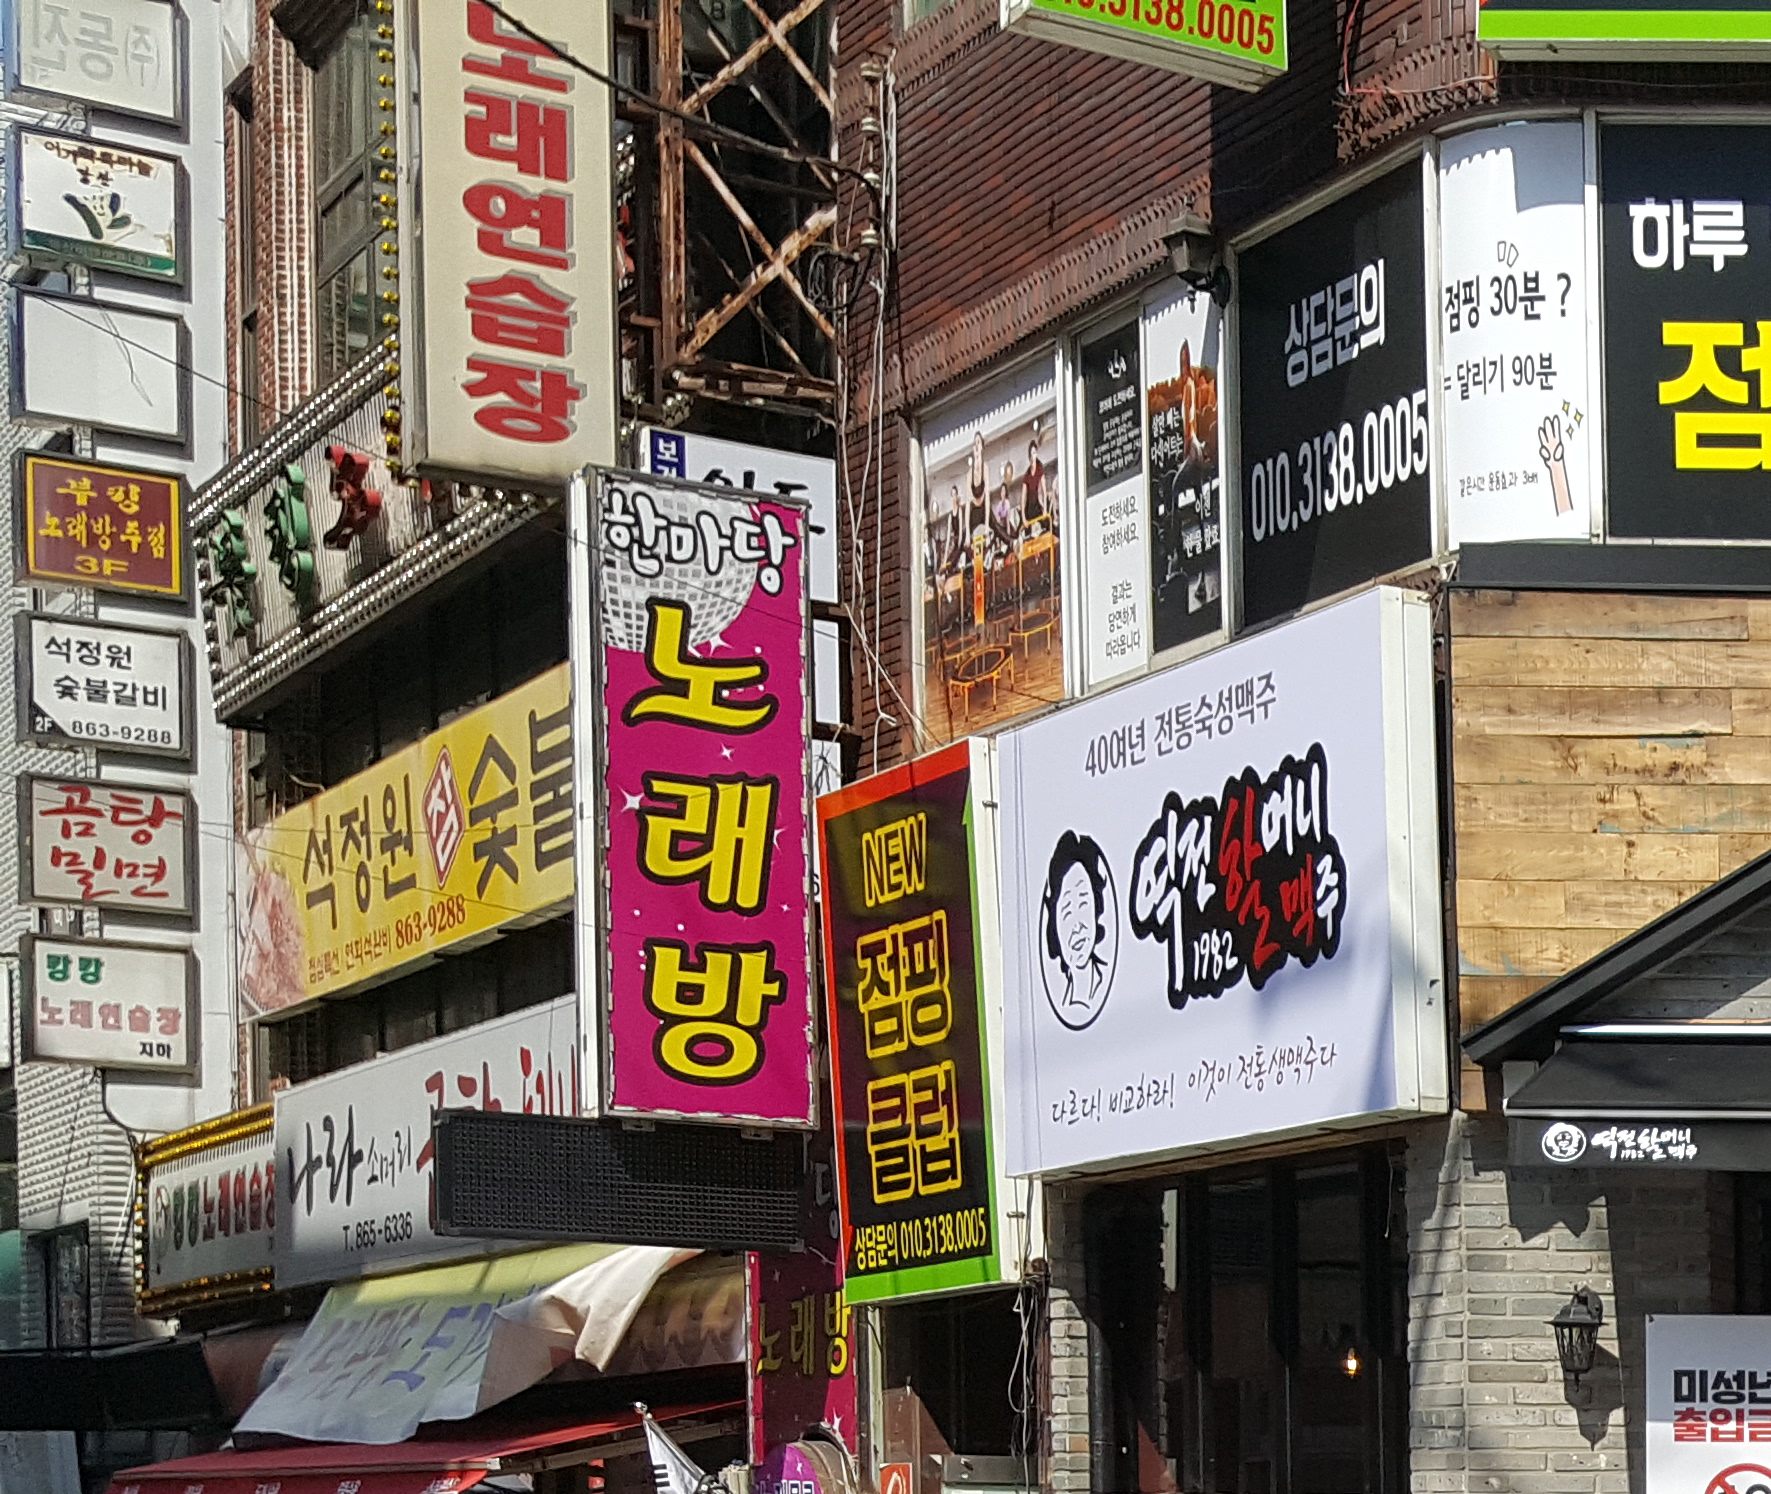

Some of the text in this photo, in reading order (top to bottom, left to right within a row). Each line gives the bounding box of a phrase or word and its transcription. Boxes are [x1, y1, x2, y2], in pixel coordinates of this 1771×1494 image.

[1630, 196, 1749, 273] 하루
[1285, 258, 1385, 389] 상담문의
[1445, 271, 1572, 333] 점핑 30분 ?
[1456, 352, 1558, 402] 달리기 90분
[1251, 389, 1429, 543] 010.3138.0005
[38, 511, 166, 559] 노래방주점
[74, 555, 130, 577] 3F
[601, 489, 797, 595] 한마당
[44, 634, 133, 671] 석정원
[53, 674, 168, 712] 숯불갈비
[1085, 671, 1277, 779] 40여년 전통숙성맥주
[35, 717, 172, 745] 2F 863-9288
[51, 846, 170, 898] 밀면
[303, 772, 417, 931] 석정원
[622, 601, 790, 1086] 노래방
[861, 811, 928, 908] NEW
[395, 893, 466, 951] 863-9288
[856, 910, 953, 1060] 점핑
[1192, 929, 1239, 982] 1982
[39, 996, 182, 1036] 노래연습장
[1051, 1034, 1337, 1127] 다르다! 비교하라! 이것이 전통생맥주다
[287, 1104, 364, 1217] 나라
[866, 1060, 962, 1205] 클럽
[342, 1212, 413, 1253] T.865-6336
[855, 1206, 987, 1271] 상담문의 010.3138.0005
